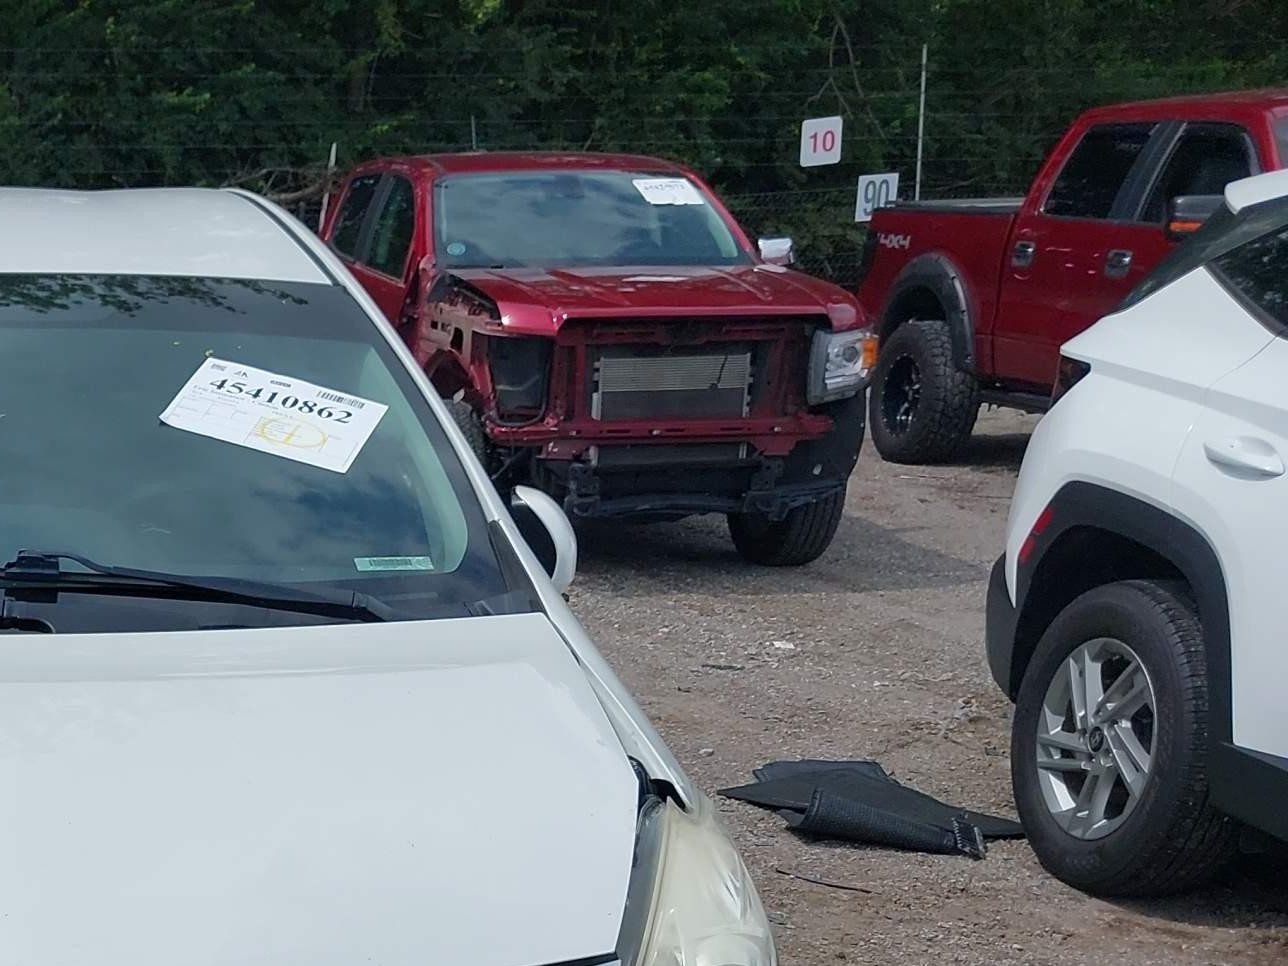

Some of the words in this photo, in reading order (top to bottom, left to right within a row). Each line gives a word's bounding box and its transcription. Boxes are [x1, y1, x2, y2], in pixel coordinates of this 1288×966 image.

[810, 130, 835, 153] 10
[863, 179, 890, 216] 90
[209, 378, 352, 424] 45410862
